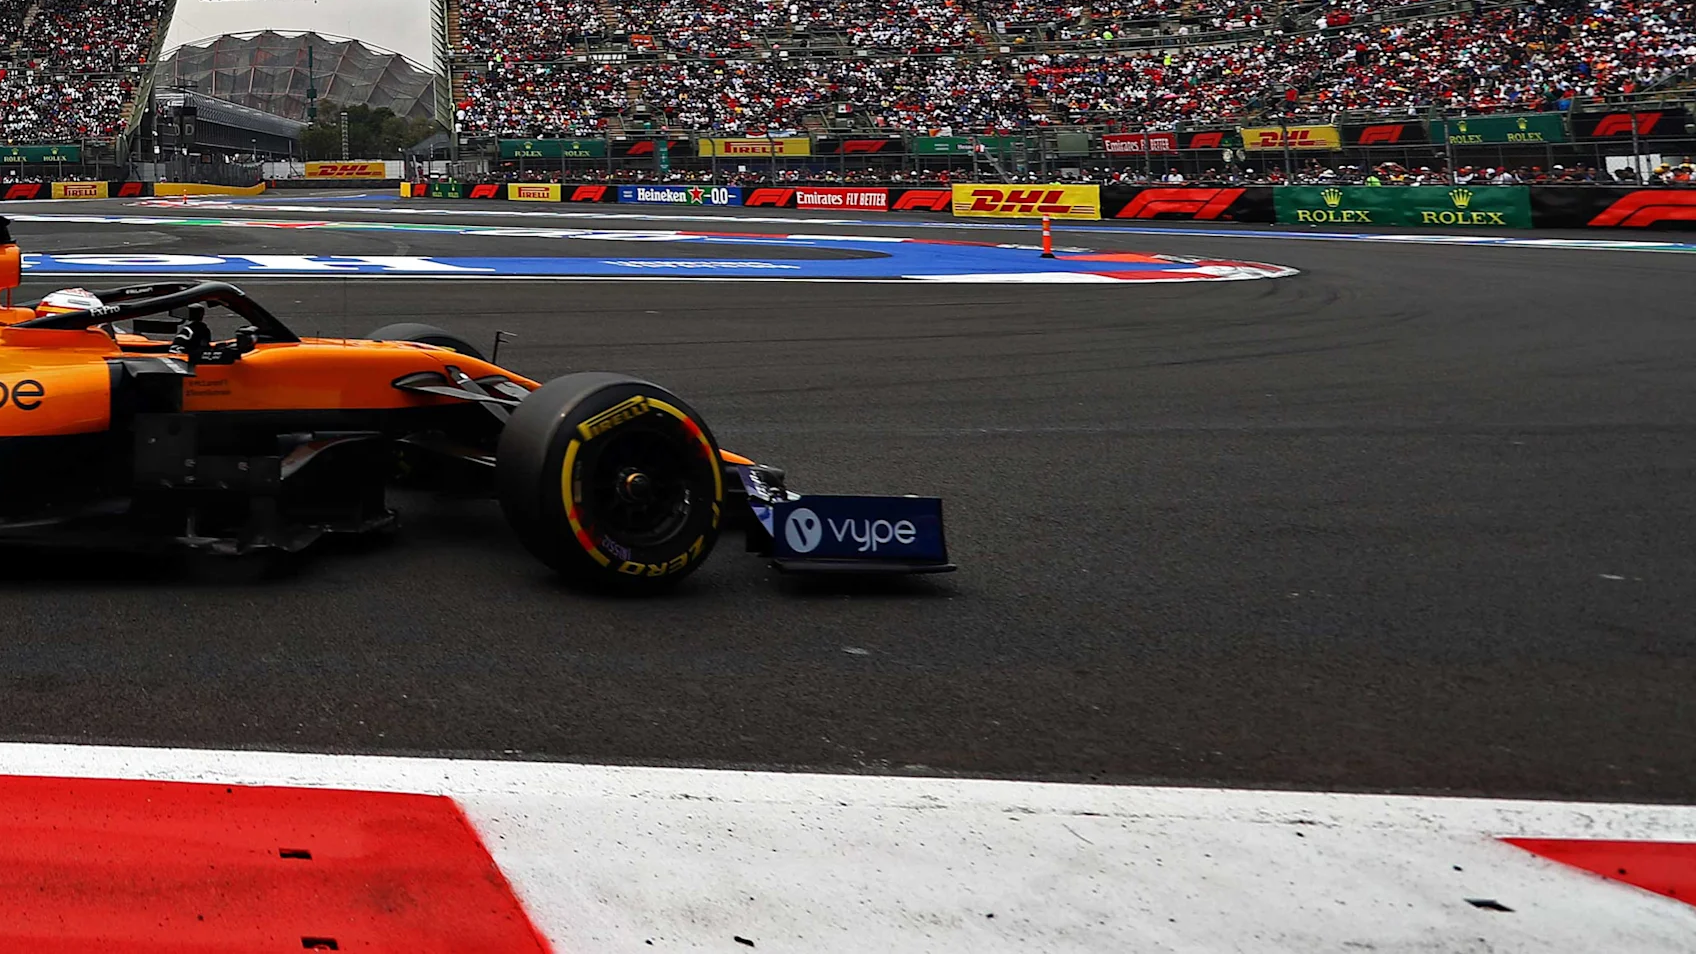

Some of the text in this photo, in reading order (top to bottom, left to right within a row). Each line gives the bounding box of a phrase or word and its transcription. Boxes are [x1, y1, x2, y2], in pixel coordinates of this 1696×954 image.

[1260, 130, 1317, 146] DHL
[1450, 132, 1543, 144] ROLEX ROLEX
[724, 141, 784, 154] PIRELLI
[1105, 140, 1139, 152] Emirates
[317, 164, 374, 176] DHL
[64, 184, 97, 197] PIRELLI
[518, 186, 550, 199] PIRELLI
[637, 187, 687, 203] Heineken
[797, 192, 886, 207] Emirates FLY BETTER
[970, 190, 1074, 214] DHL
[1297, 210, 1506, 225] ROLEX ROLEX
[90, 304, 121, 317] FxPro
[577, 395, 651, 441] PIRELLI
[827, 517, 917, 552] vype
[617, 535, 704, 577] ZERO
